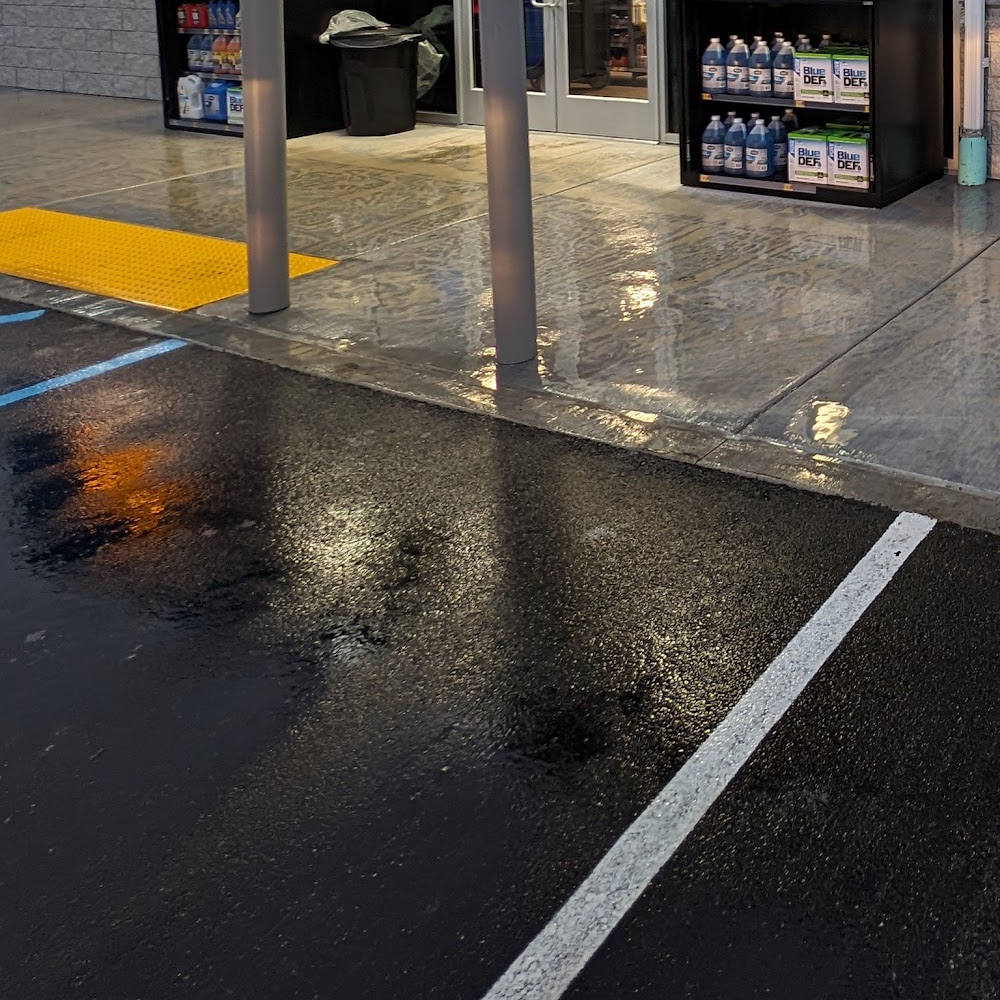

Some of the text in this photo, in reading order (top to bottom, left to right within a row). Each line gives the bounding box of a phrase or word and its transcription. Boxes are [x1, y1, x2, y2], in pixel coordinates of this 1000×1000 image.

[803, 66, 825, 75] Blue
[843, 68, 866, 77] Blue
[803, 75, 825, 85] DEF
[843, 77, 866, 87] DEF
[798, 147, 820, 156] Blue
[837, 150, 860, 160] Blue
[798, 156, 820, 167] DEF
[837, 160, 860, 170] DEF
